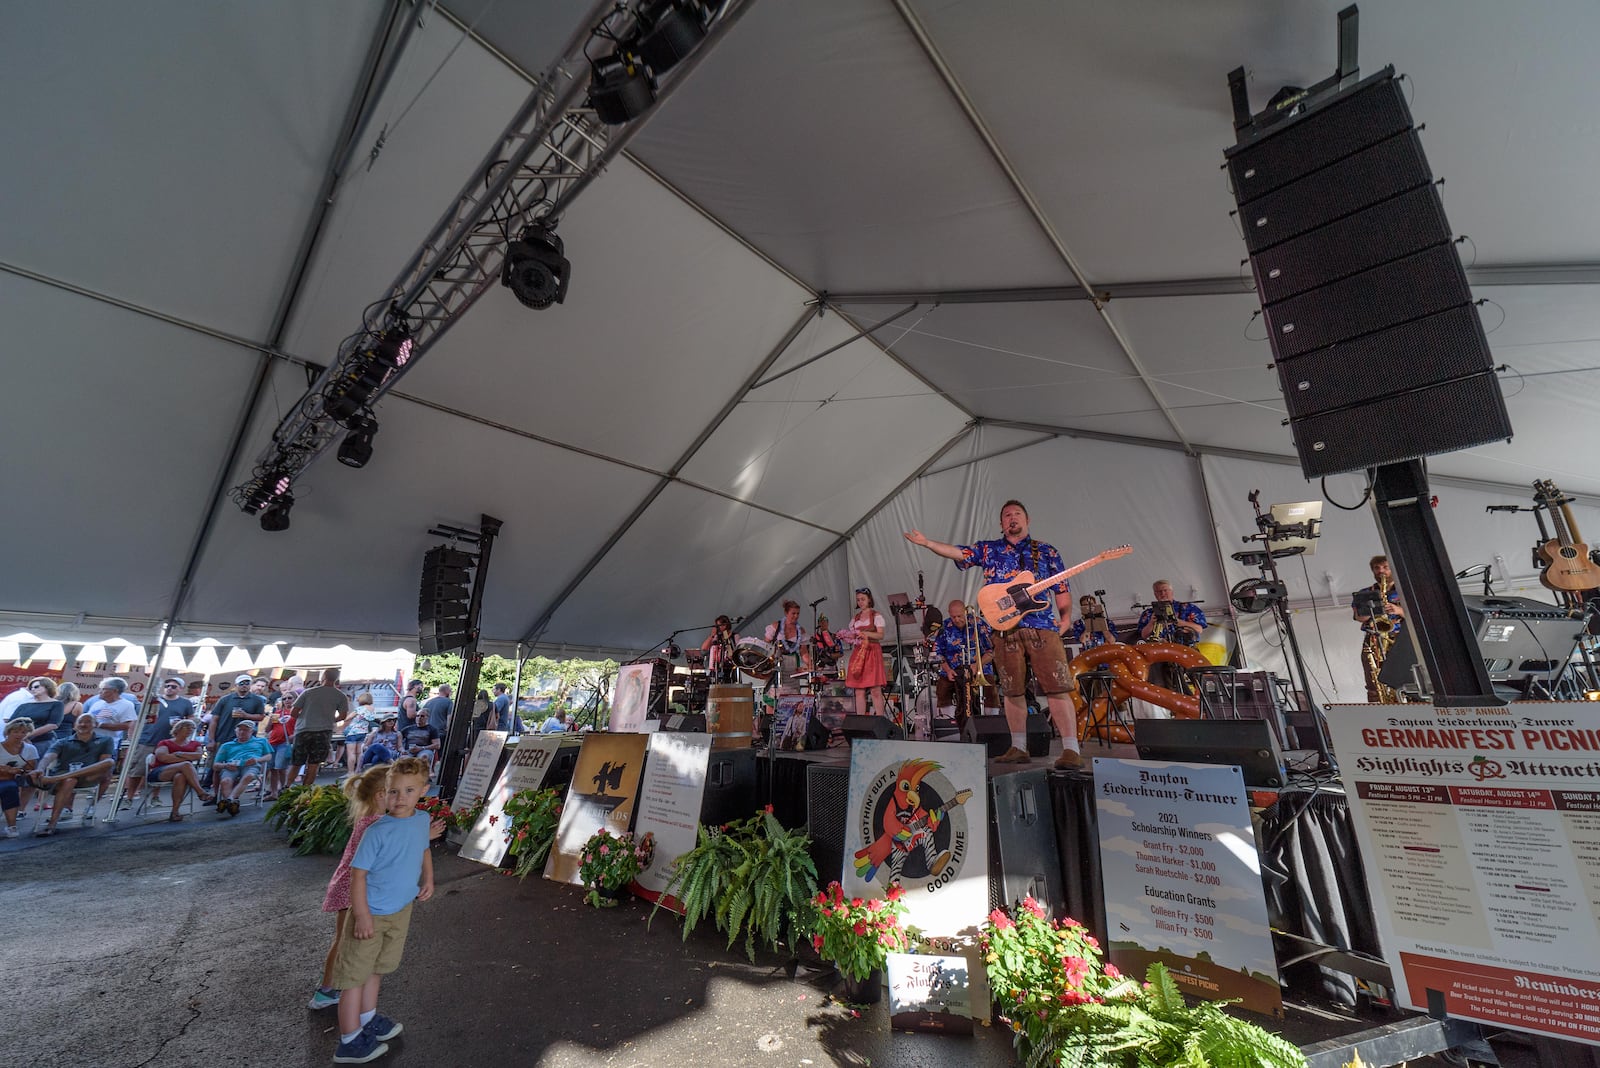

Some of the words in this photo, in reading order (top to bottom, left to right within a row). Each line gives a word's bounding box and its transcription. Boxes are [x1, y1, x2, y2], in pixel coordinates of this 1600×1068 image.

[1436, 708, 1452, 716] THE
[1476, 708, 1512, 716] ANNUAL
[1387, 718, 1433, 728] Dayton
[1361, 728, 1516, 750] GERMANFEST
[512, 748, 551, 769] BEER!
[1356, 756, 1464, 776] Highlights
[1139, 770, 1189, 786] Dayton
[1103, 782, 1238, 805] Liederkranz-Turner
[1459, 788, 1496, 797] SATURDAY,
[1497, 790, 1524, 798] AUGUST
[862, 794, 873, 844] NOTHIN'
[872, 775, 887, 794] BUT
[889, 770, 896, 778] A
[1158, 812, 1178, 824] 2021
[1132, 822, 1176, 838] Scholarship
[1178, 827, 1212, 841] Winners
[1143, 840, 1160, 850] Grant
[1162, 842, 1174, 853] Fry
[1179, 844, 1204, 856] $2,000
[927, 866, 955, 893] GOOD
[951, 831, 965, 864] TIME
[1136, 851, 1160, 863] Thomas
[1162, 855, 1184, 866] Harker
[1190, 859, 1216, 872] $1,000
[1136, 864, 1154, 874] Sarah
[1194, 872, 1220, 886] $2,000
[1144, 886, 1185, 903] Education
[1186, 893, 1216, 909] Grants
[1150, 904, 1176, 916] Colleen
[1177, 910, 1188, 922] Fry
[1195, 913, 1214, 926] $500
[1156, 920, 1174, 932] Jillian
[1176, 924, 1188, 936] Fry
[1194, 927, 1213, 940] $500
[1462, 983, 1478, 991] ticket
[1479, 986, 1494, 994] sales
[1496, 988, 1504, 996] for
[1504, 990, 1518, 998] Beer
[1549, 998, 1560, 1006] will
[1581, 1004, 1600, 1012] HOUR
[1470, 1004, 1480, 1012] The
[1482, 1006, 1496, 1015] Food
[1497, 1008, 1509, 1017] Tent
[1522, 1014, 1538, 1022] close
[1568, 1022, 1578, 1030] ON
[1509, 1001, 1524, 1010] Tents
[1525, 1004, 1536, 1012] will
[1538, 1007, 1550, 1015] stop
[1552, 1009, 1574, 1019] serving
